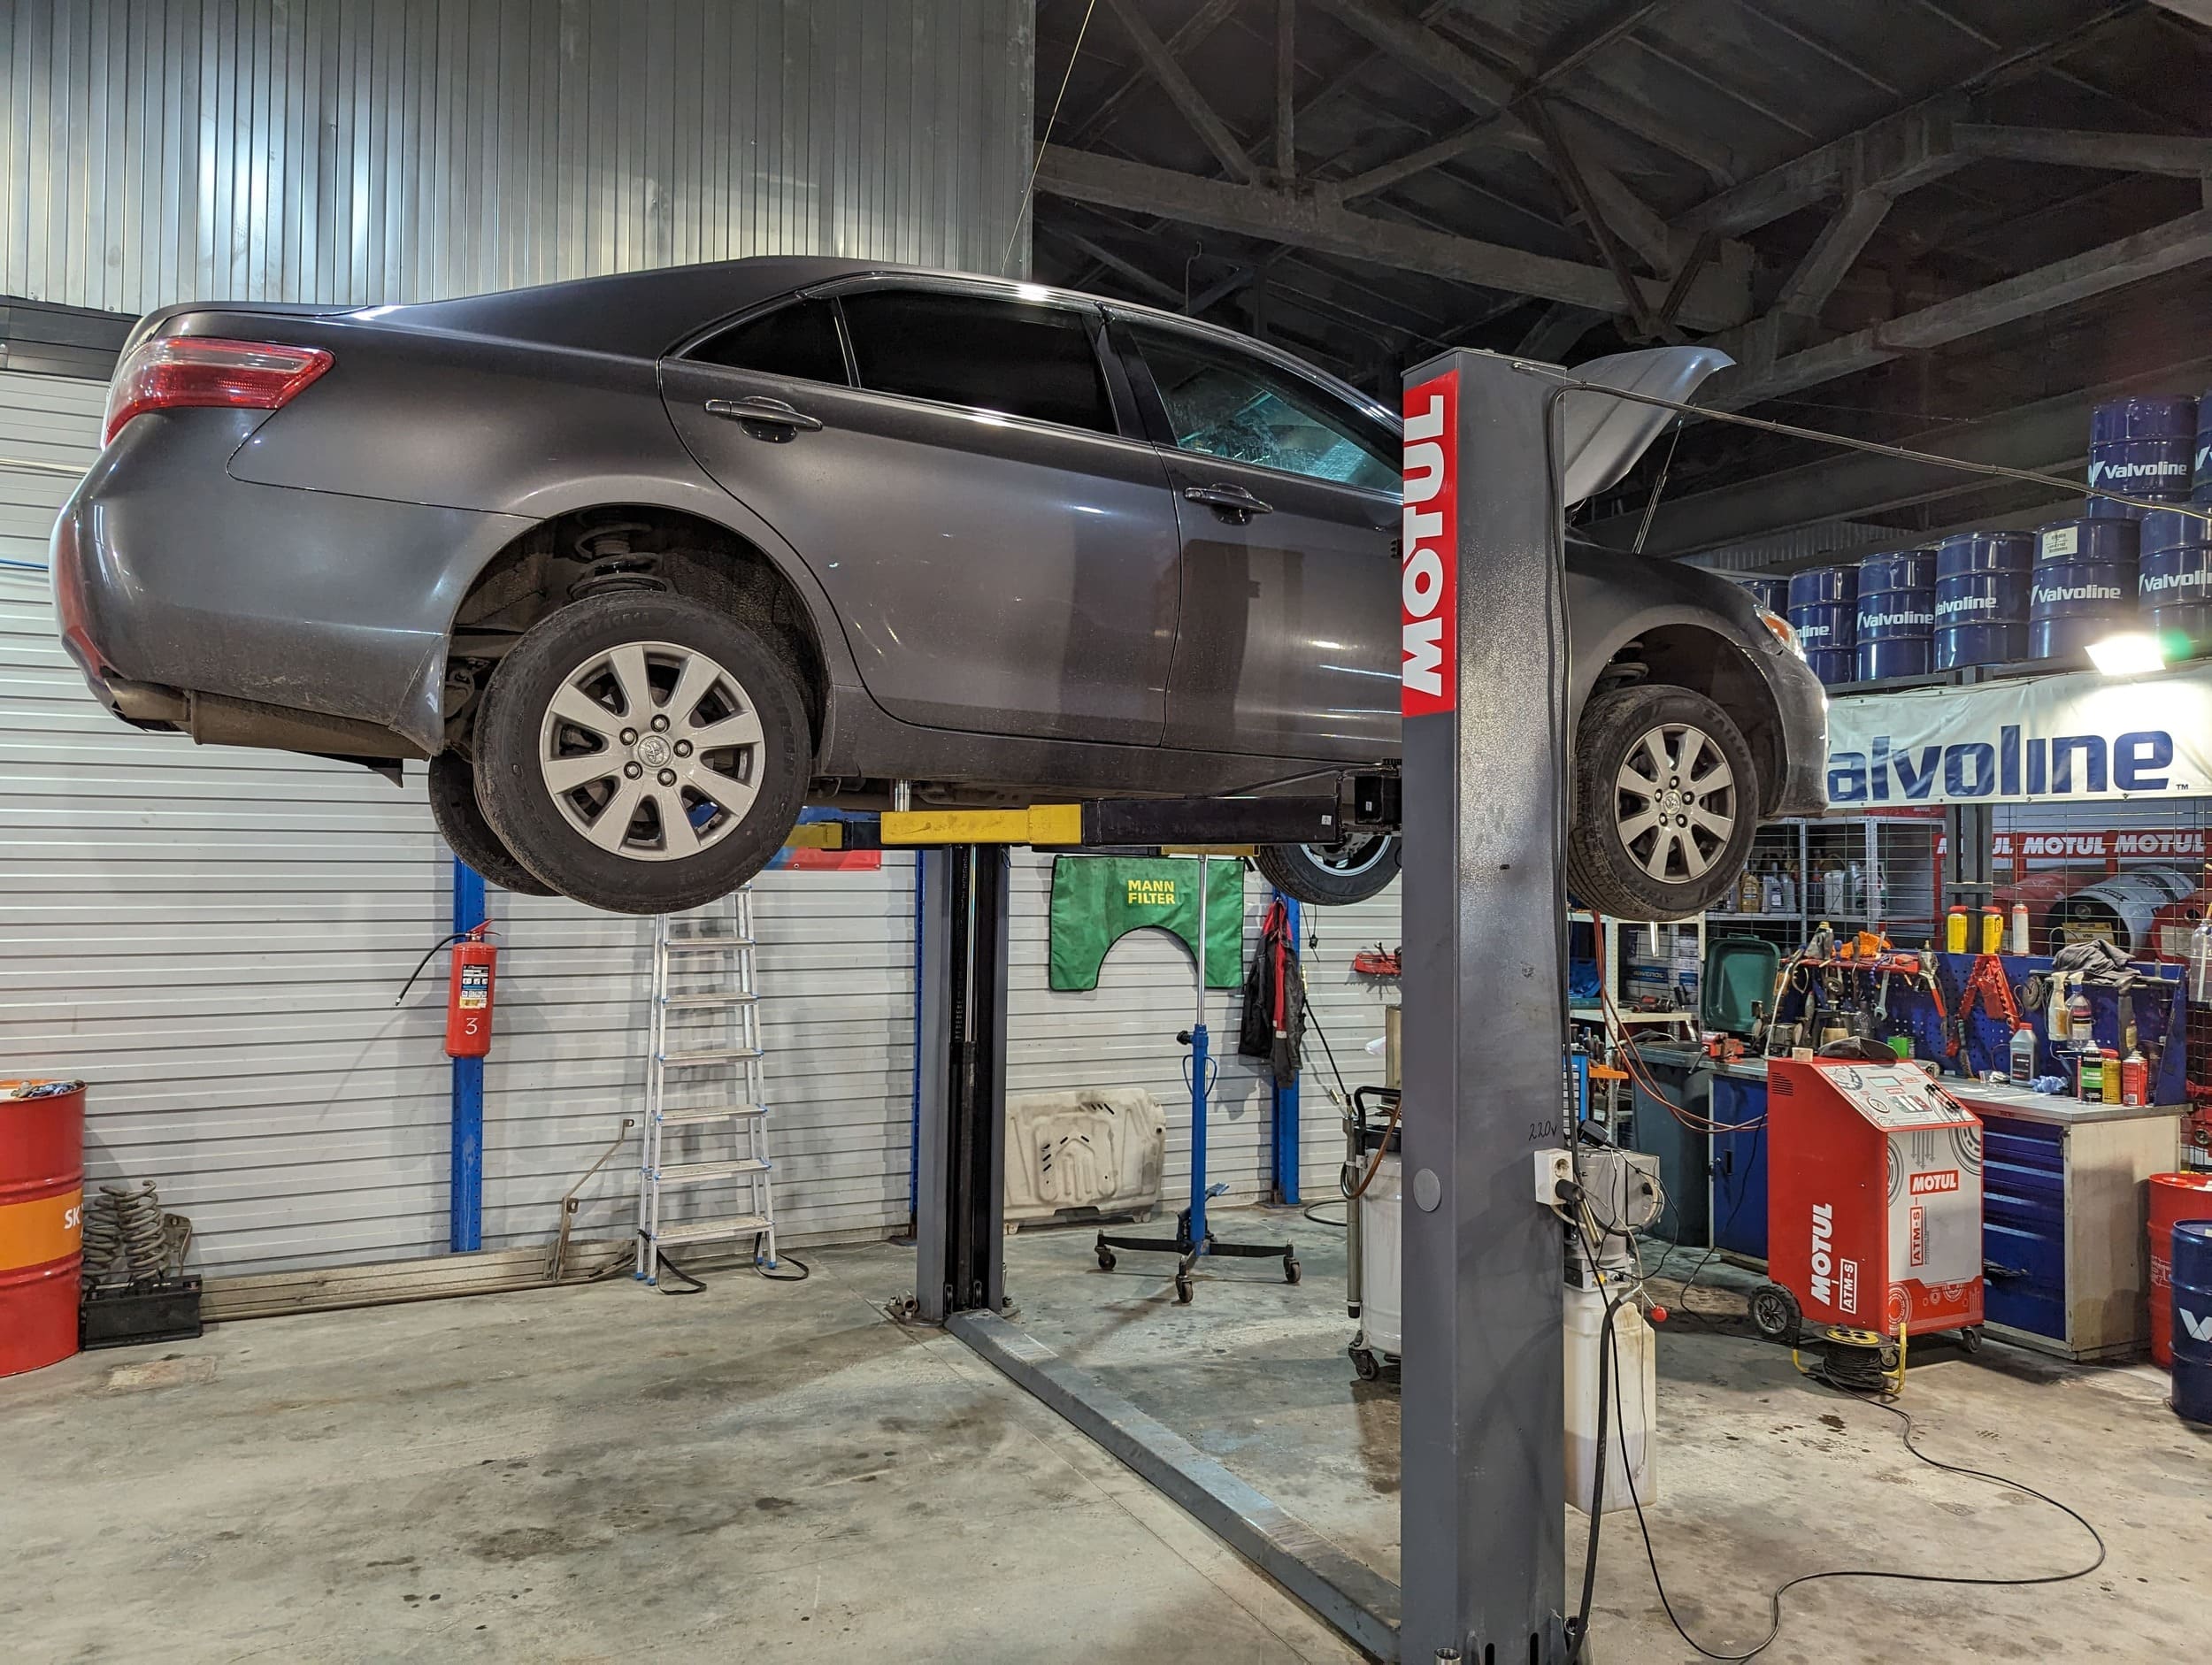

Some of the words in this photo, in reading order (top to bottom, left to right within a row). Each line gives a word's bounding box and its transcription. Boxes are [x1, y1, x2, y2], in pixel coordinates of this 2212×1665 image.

[2105, 462, 2188, 479] Valvoline
[1402, 395, 1445, 697] MOTUL
[2039, 585, 2122, 602] Valvoline
[1863, 611, 1934, 628] Valvoline
[1827, 724, 2174, 802] alvoline
[2023, 836, 2107, 856] MOTUL
[2114, 834, 2206, 854] MOTUL
[1128, 879, 1175, 892] MANN
[1128, 893, 1176, 904] FILTER
[465, 1017, 479, 1035] 3
[1912, 1173, 1957, 1193] MOTUL
[64, 1205, 81, 1229] SK
[1811, 1203, 1832, 1306] MOTUL
[1843, 1264, 1855, 1309] ATM-S
